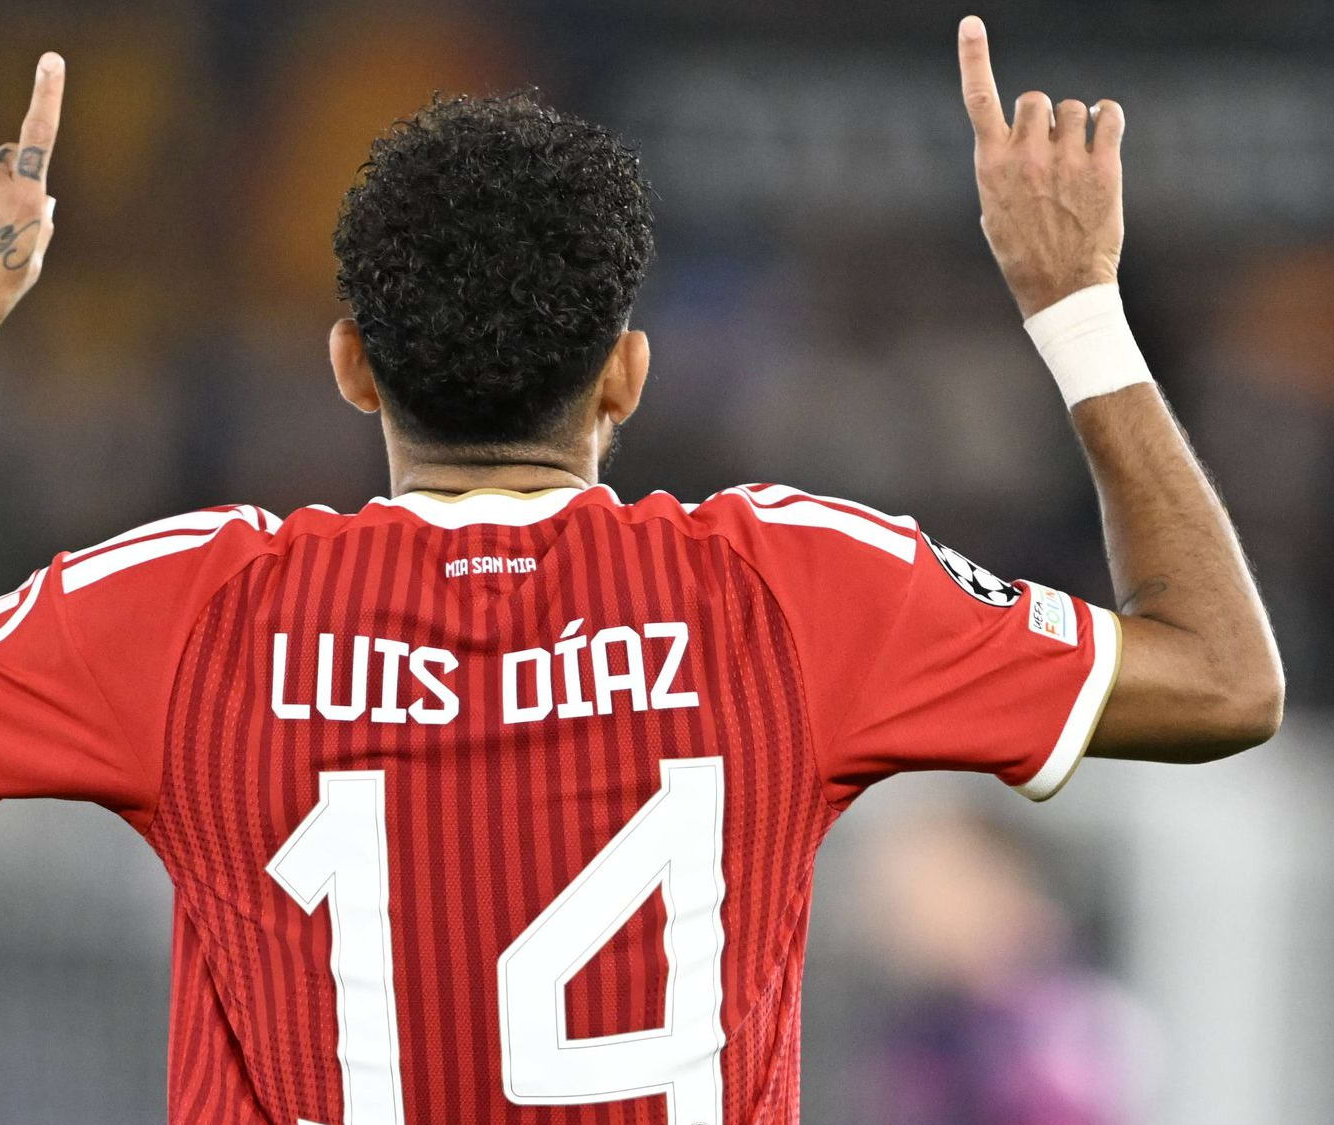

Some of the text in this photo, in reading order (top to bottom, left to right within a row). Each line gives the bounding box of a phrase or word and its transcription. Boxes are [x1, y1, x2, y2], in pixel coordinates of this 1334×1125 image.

[445, 556, 537, 578] MIA SAN MIA
[1033, 600, 1044, 630] UEFA
[271, 618, 700, 725] LUIS DÍAZ
